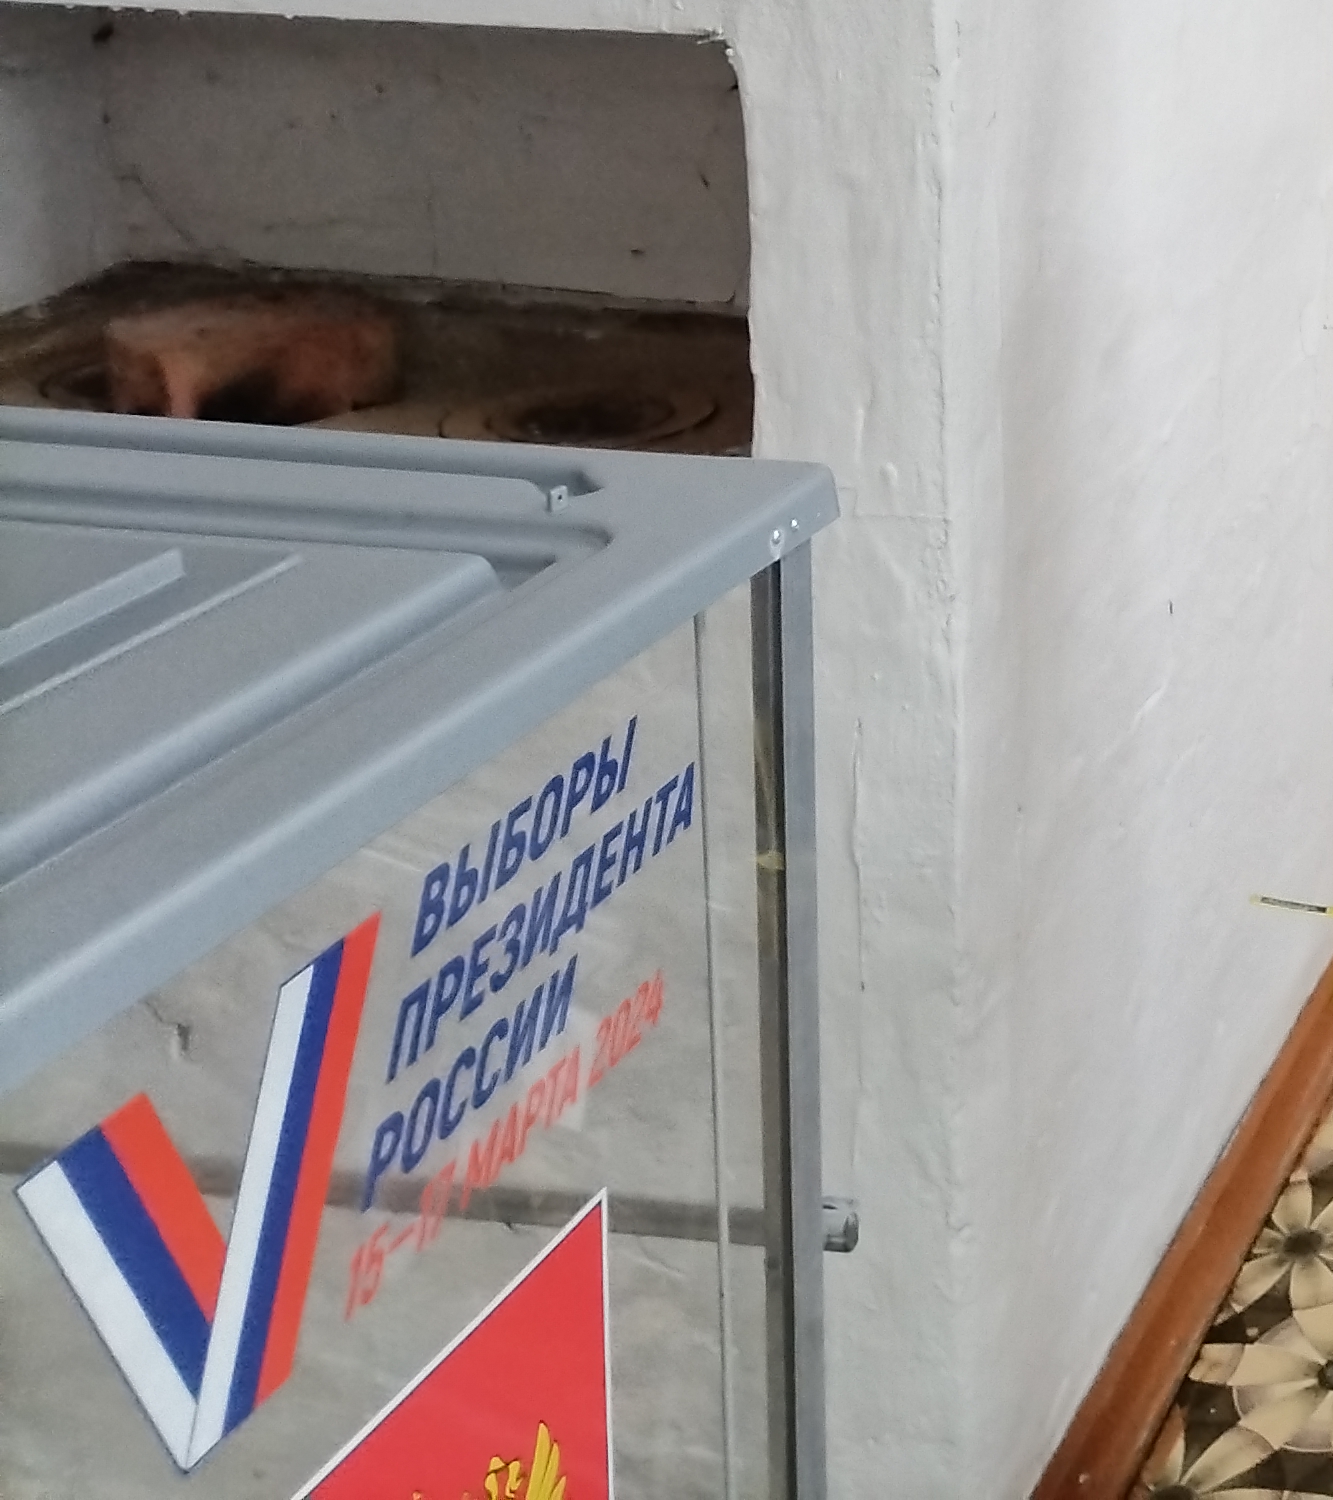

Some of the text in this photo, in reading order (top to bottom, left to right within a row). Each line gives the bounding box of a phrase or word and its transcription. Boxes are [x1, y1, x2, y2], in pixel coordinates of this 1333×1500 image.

[385, 760, 696, 1085] ПРЕЗИДЕНТА
[410, 713, 639, 959] ВЫБОРЫ
[359, 952, 579, 1214] РОССИИ
[459, 1043, 581, 1212] МАРТА
[587, 967, 665, 1089] 2024
